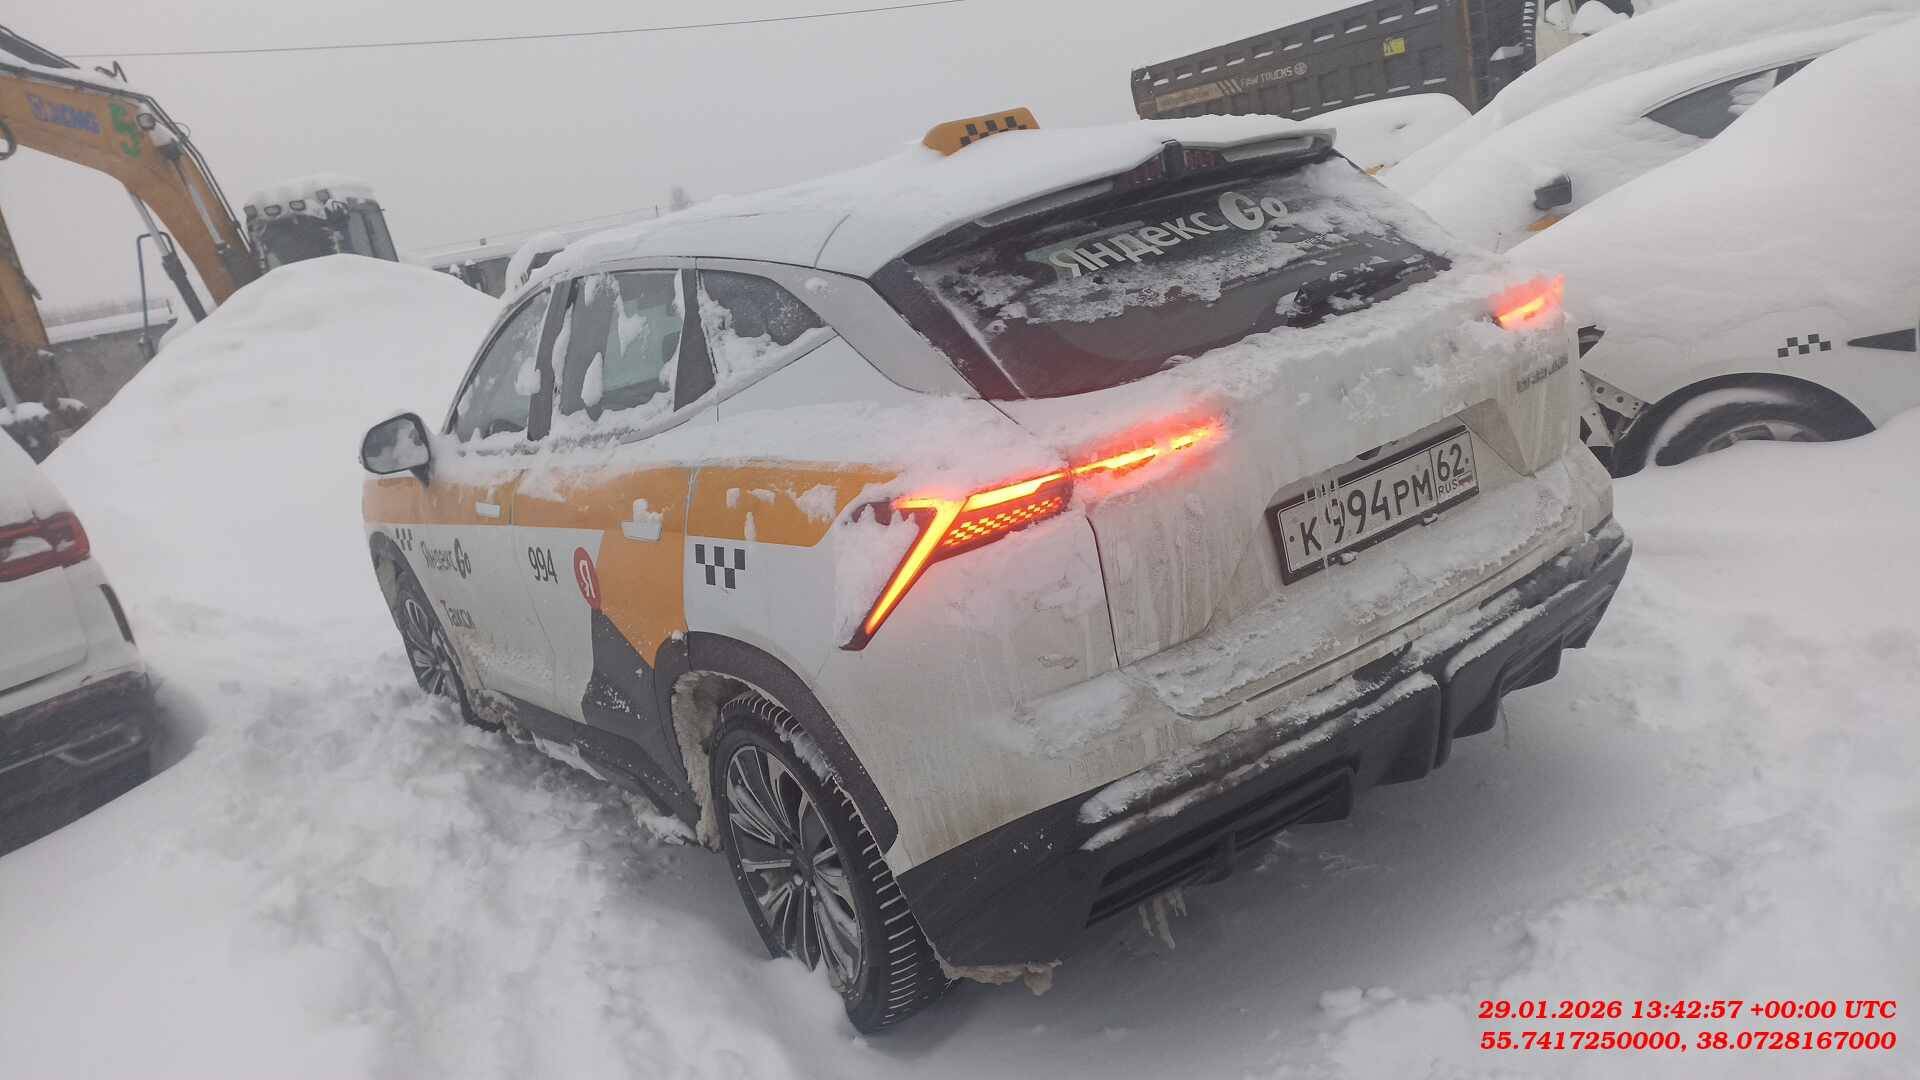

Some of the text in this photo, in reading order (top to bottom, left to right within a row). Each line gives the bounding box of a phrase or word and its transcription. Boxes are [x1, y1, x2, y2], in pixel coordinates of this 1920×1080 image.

[110, 103, 141, 158] 5
[1049, 191, 1289, 278] Яндекс Go
[1437, 443, 1466, 482] 62
[1438, 479, 1459, 496] RUS
[454, 537, 472, 580] Go
[528, 546, 559, 585] 994
[578, 559, 597, 600] Я
